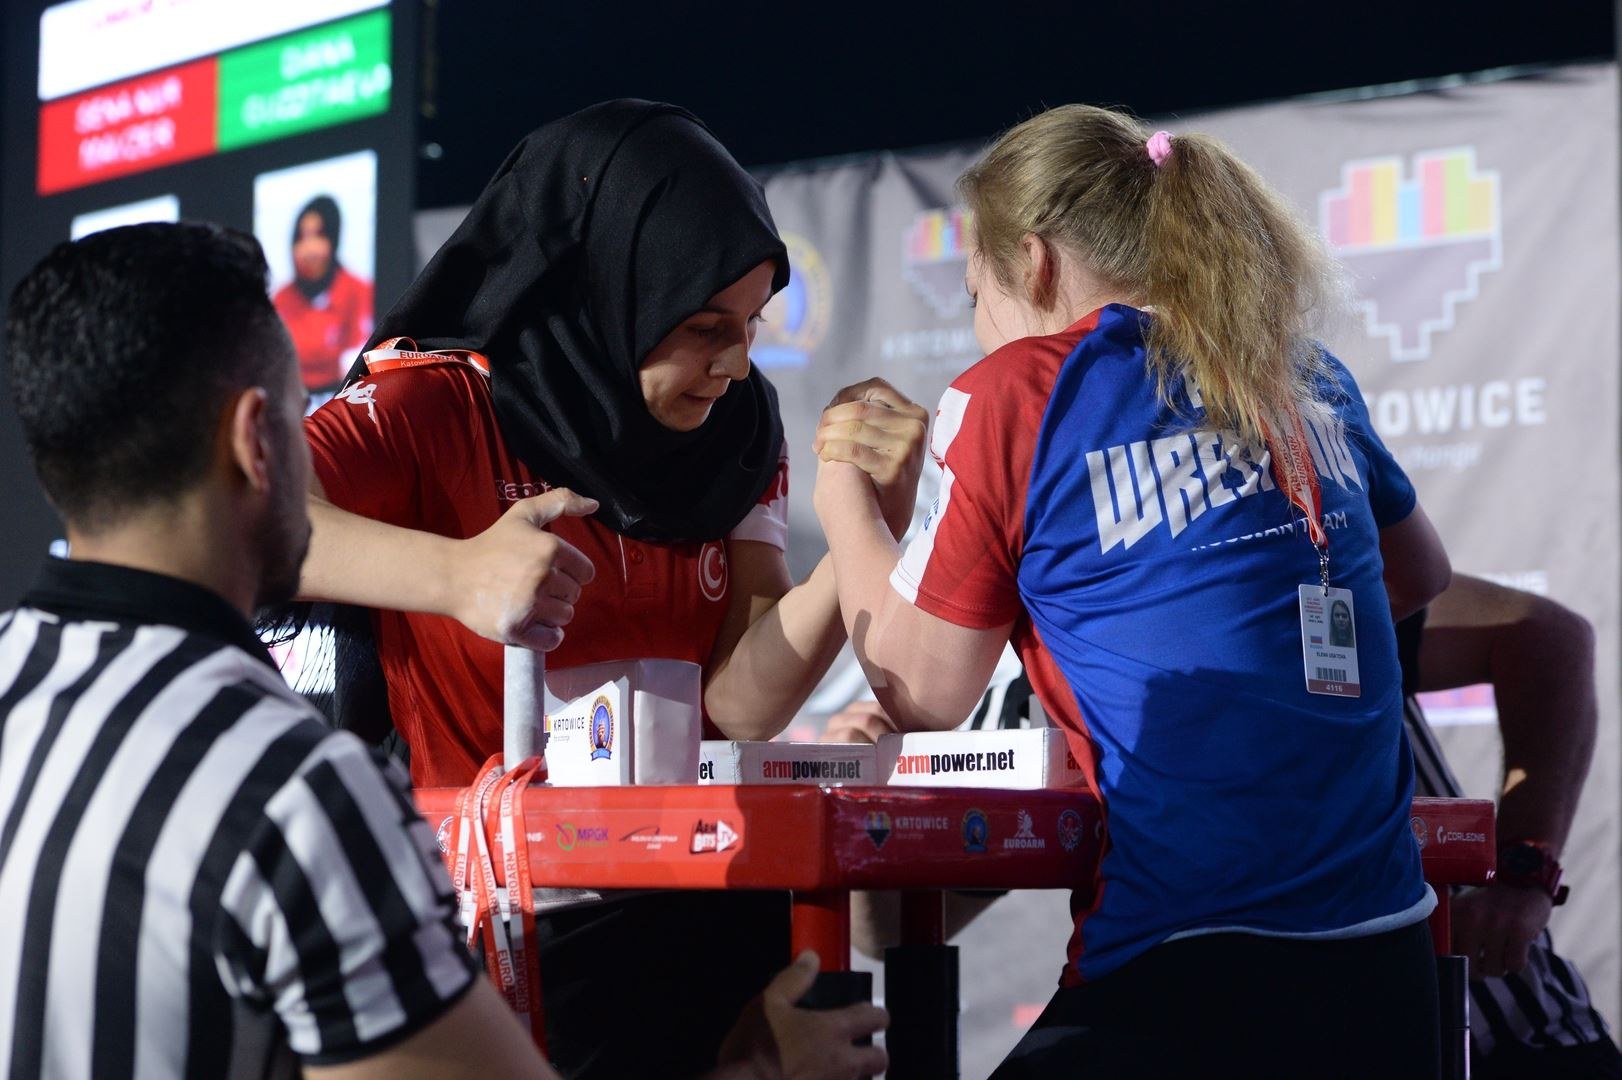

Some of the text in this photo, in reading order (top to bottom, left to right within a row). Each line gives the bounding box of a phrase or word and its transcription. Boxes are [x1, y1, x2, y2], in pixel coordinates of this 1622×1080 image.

[1364, 377, 1548, 438] OWICE
[1297, 510, 1349, 536] TAM
[553, 716, 585, 732] KATOWICE
[763, 759, 861, 780] armpower.net
[897, 749, 1015, 775] armpower.net
[895, 816, 949, 830] KATOWICE
[1004, 838, 1046, 849] EUROARM
[455, 853, 466, 905] EUROA
[480, 854, 500, 915] EUROARM
[506, 852, 522, 914] EUROARM
